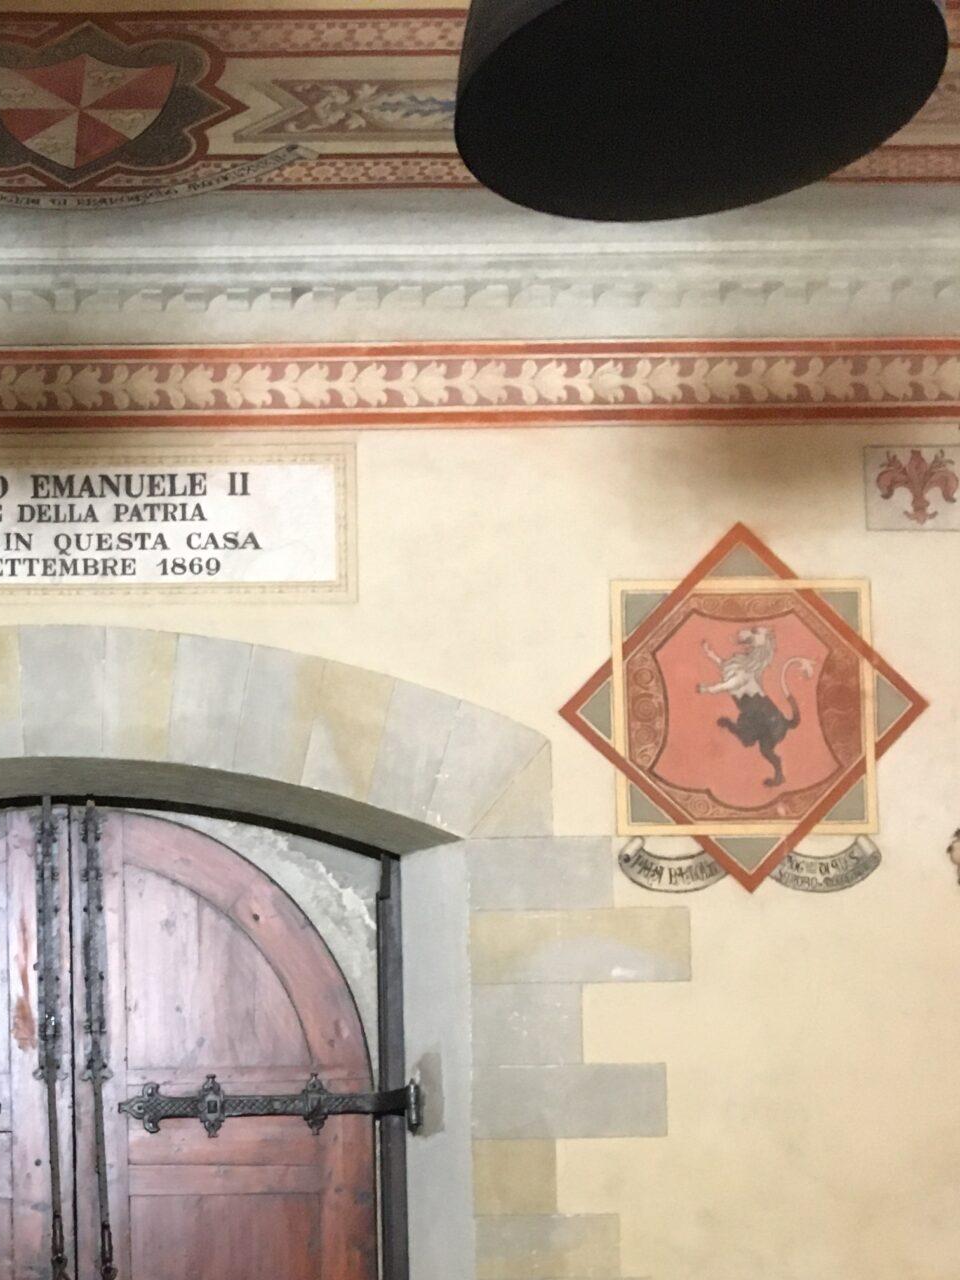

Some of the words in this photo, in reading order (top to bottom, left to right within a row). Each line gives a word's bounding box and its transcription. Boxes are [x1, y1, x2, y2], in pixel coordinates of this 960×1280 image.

[31, 472, 206, 499] EMANUELE
[228, 472, 251, 497] II
[17, 504, 99, 523] DELLA
[114, 503, 207, 522] PATRIA
[5, 533, 32, 552] IN
[54, 532, 170, 556] QUESTA
[186, 532, 262, 551] CASA
[157, 557, 221, 576] 1869
